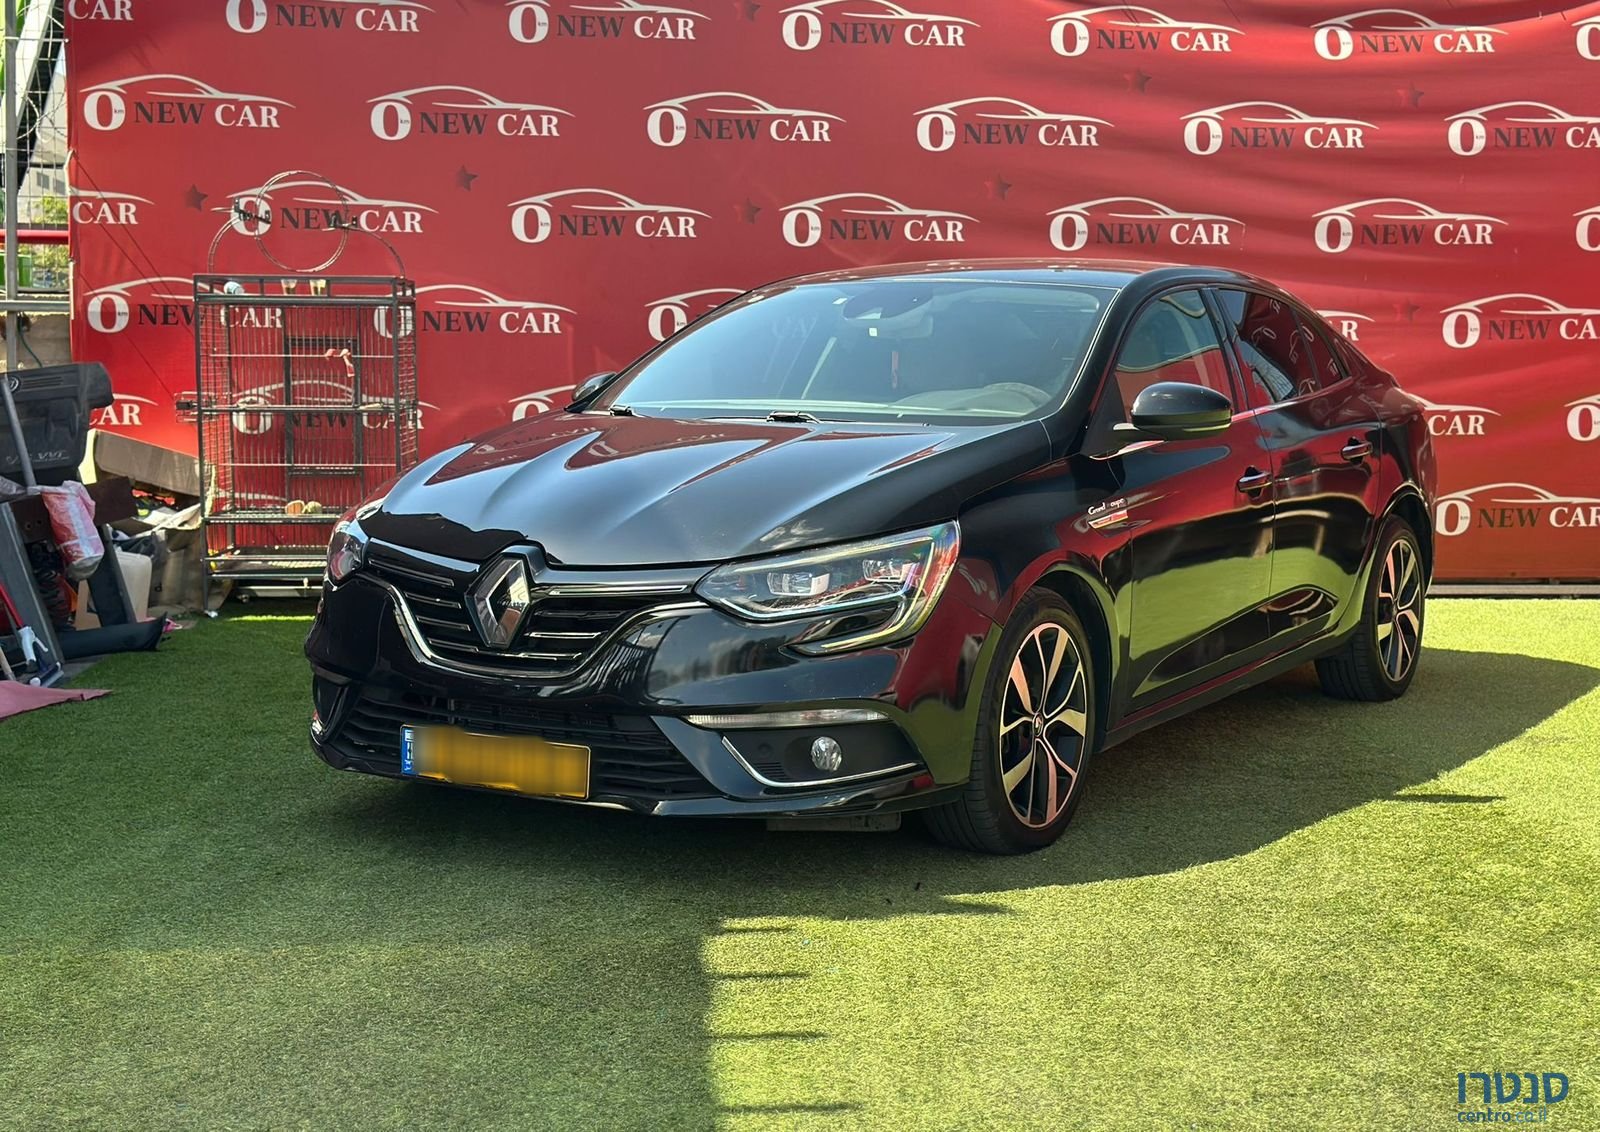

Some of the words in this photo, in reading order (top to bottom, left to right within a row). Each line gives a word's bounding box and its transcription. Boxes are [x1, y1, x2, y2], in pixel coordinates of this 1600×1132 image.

[68, 0, 134, 21] CAR
[276, 4, 345, 29] NEW
[355, 9, 420, 32] CAR
[557, 15, 624, 38] NEW
[633, 17, 696, 40] CAR
[829, 22, 895, 44] NEW
[904, 24, 966, 47] CAR
[1097, 30, 1160, 50] NEW
[1170, 31, 1231, 52] CAR
[1360, 34, 1424, 54] NEW
[1433, 33, 1495, 53] CAR
[135, 102, 204, 124] NEW
[214, 104, 280, 128] CAR
[419, 112, 487, 135] NEW
[497, 113, 560, 136] CAR
[694, 118, 760, 140] NEW
[769, 119, 831, 142] CAR
[963, 124, 1029, 145] NEW
[1038, 125, 1098, 147] CAR
[1230, 127, 1294, 148] NEW
[1304, 127, 1364, 149] CAR
[1494, 127, 1556, 147] NEW
[72, 202, 138, 224] CAR
[360, 209, 423, 233] CAR
[559, 215, 625, 237] NEW
[635, 216, 697, 238] CAR
[829, 220, 895, 240] NEW
[904, 220, 965, 242] CAR
[1096, 224, 1160, 244] NEW
[1170, 223, 1230, 245] CAR
[1360, 224, 1424, 244] NEW
[1434, 224, 1492, 245] CAR
[220, 306, 284, 329] CAR
[422, 311, 490, 332] NEW
[499, 312, 561, 333] CAR
[1488, 319, 1551, 340] NEW
[1559, 319, 1600, 339] CA
[90, 403, 142, 426] AR
[1428, 415, 1485, 436] CAR
[1478, 508, 1540, 528] NEW
